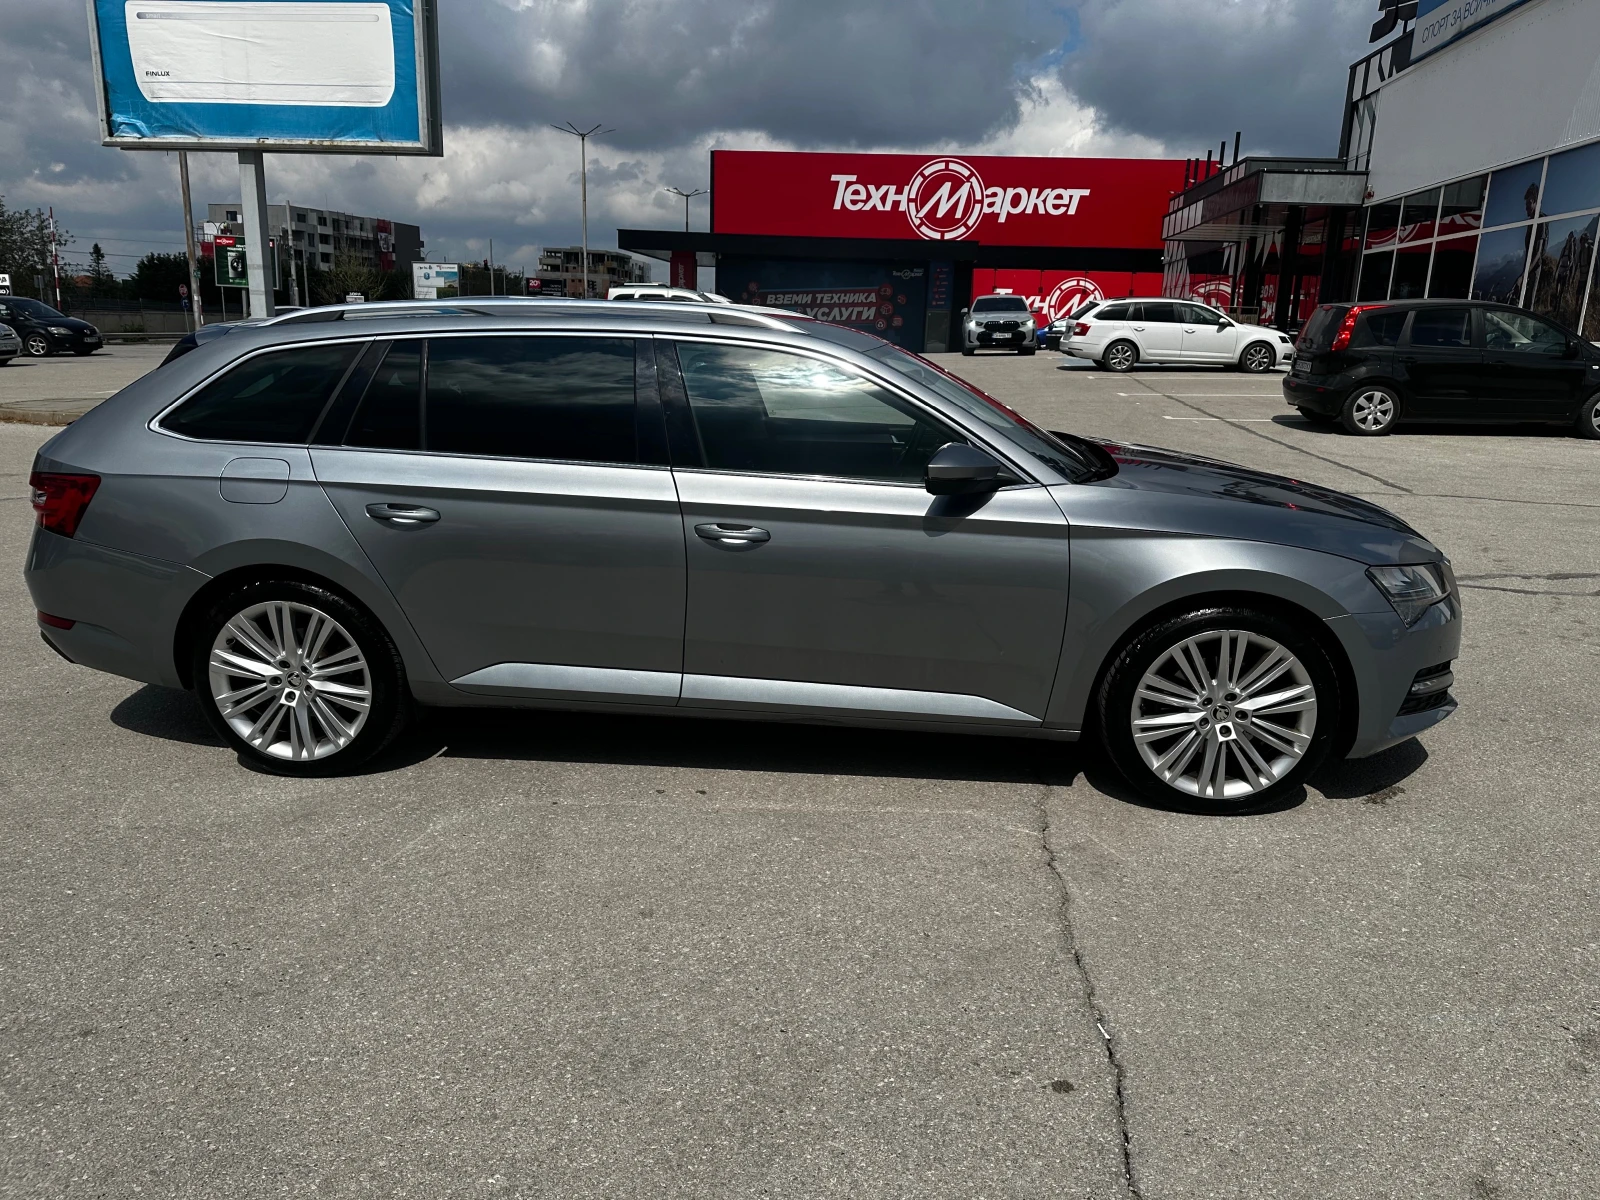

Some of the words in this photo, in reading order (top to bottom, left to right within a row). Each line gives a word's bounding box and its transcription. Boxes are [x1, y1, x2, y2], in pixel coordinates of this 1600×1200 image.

[1421, 13, 1451, 43] СПОРТ
[1450, 6, 1462, 27] ЗА
[766, 294, 812, 305] ВЗЕМИ
[815, 292, 877, 304] ТЕХНИКА
[805, 306, 877, 321] УСЛУГИ
